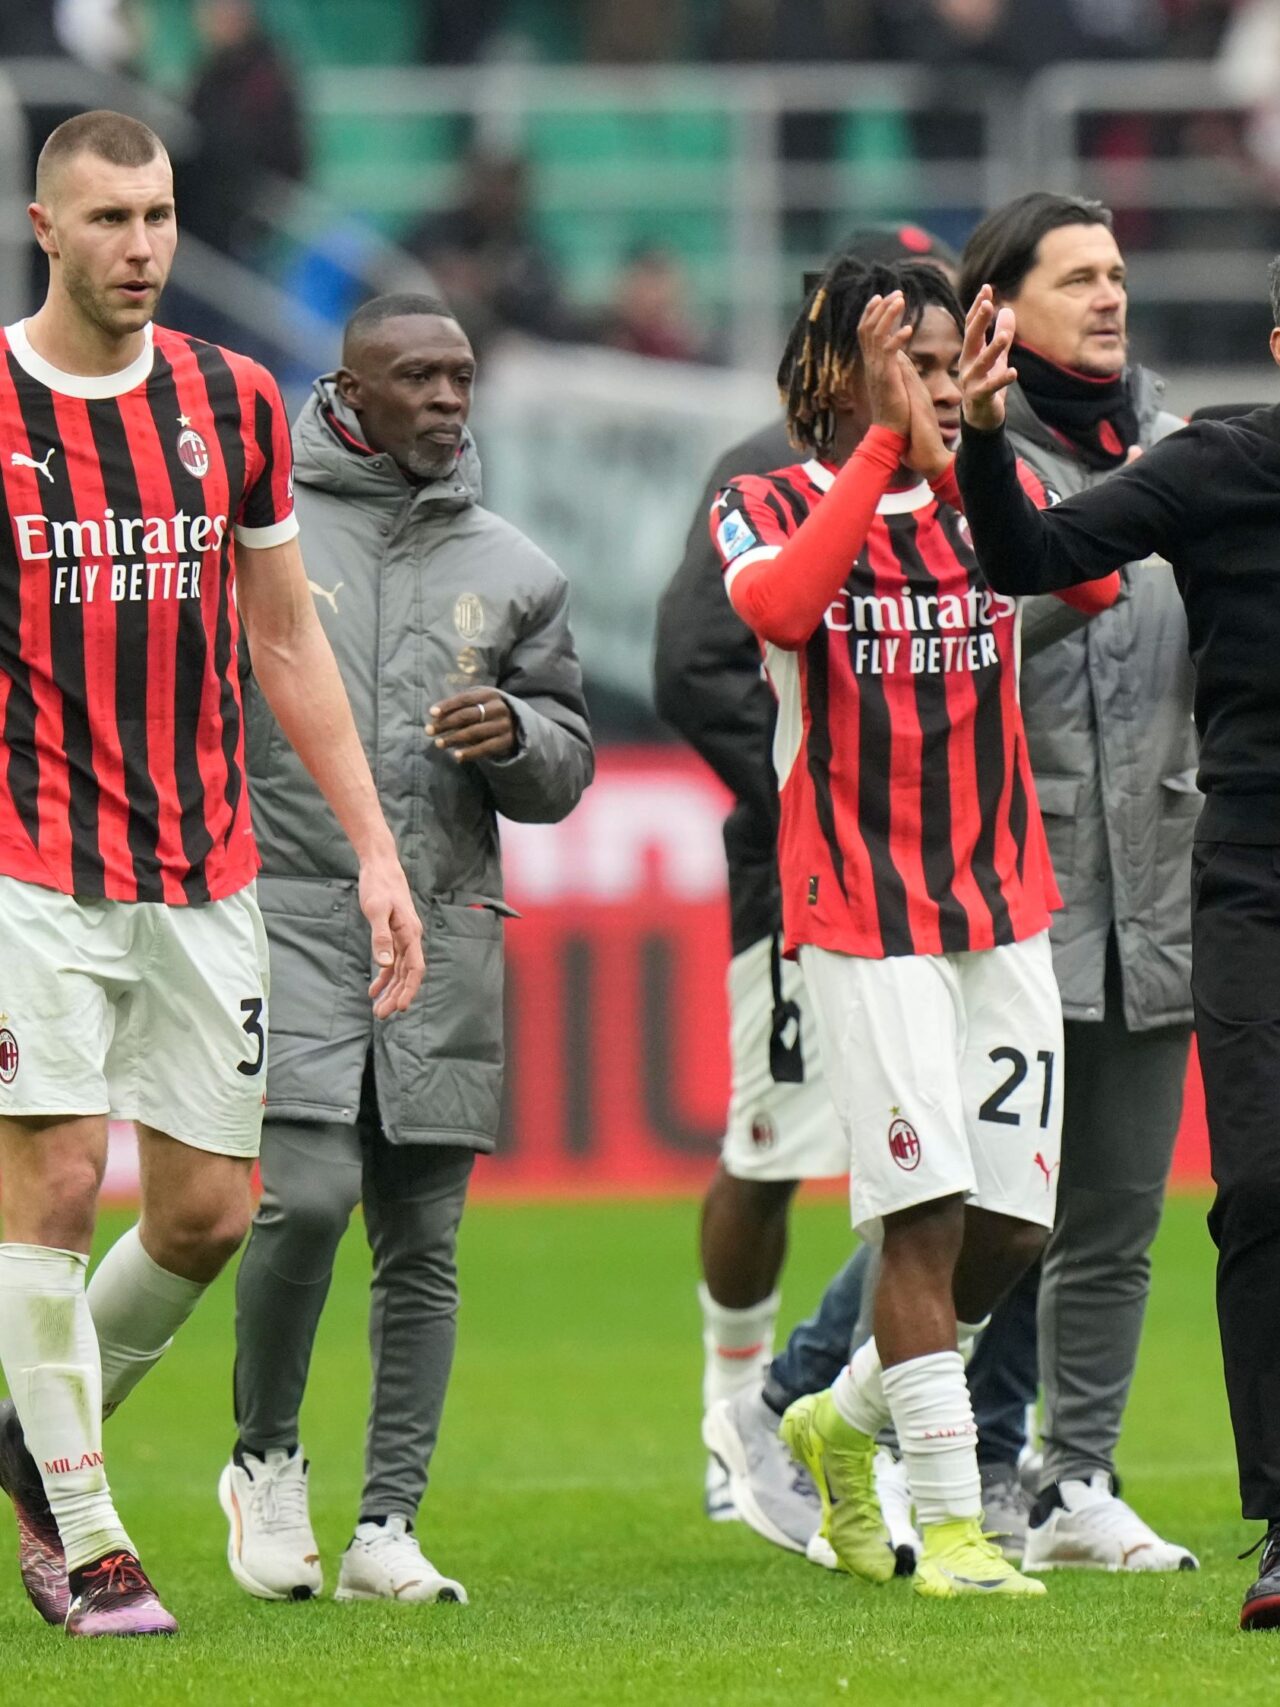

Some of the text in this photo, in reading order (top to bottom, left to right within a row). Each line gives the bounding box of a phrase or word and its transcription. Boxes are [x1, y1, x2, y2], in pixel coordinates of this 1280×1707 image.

[14, 509, 227, 561] Emirates
[54, 562, 201, 604] FLY BETTER
[856, 633, 998, 674] FLY BETTER
[237, 998, 264, 1076] 3
[979, 1046, 1054, 1129] 21
